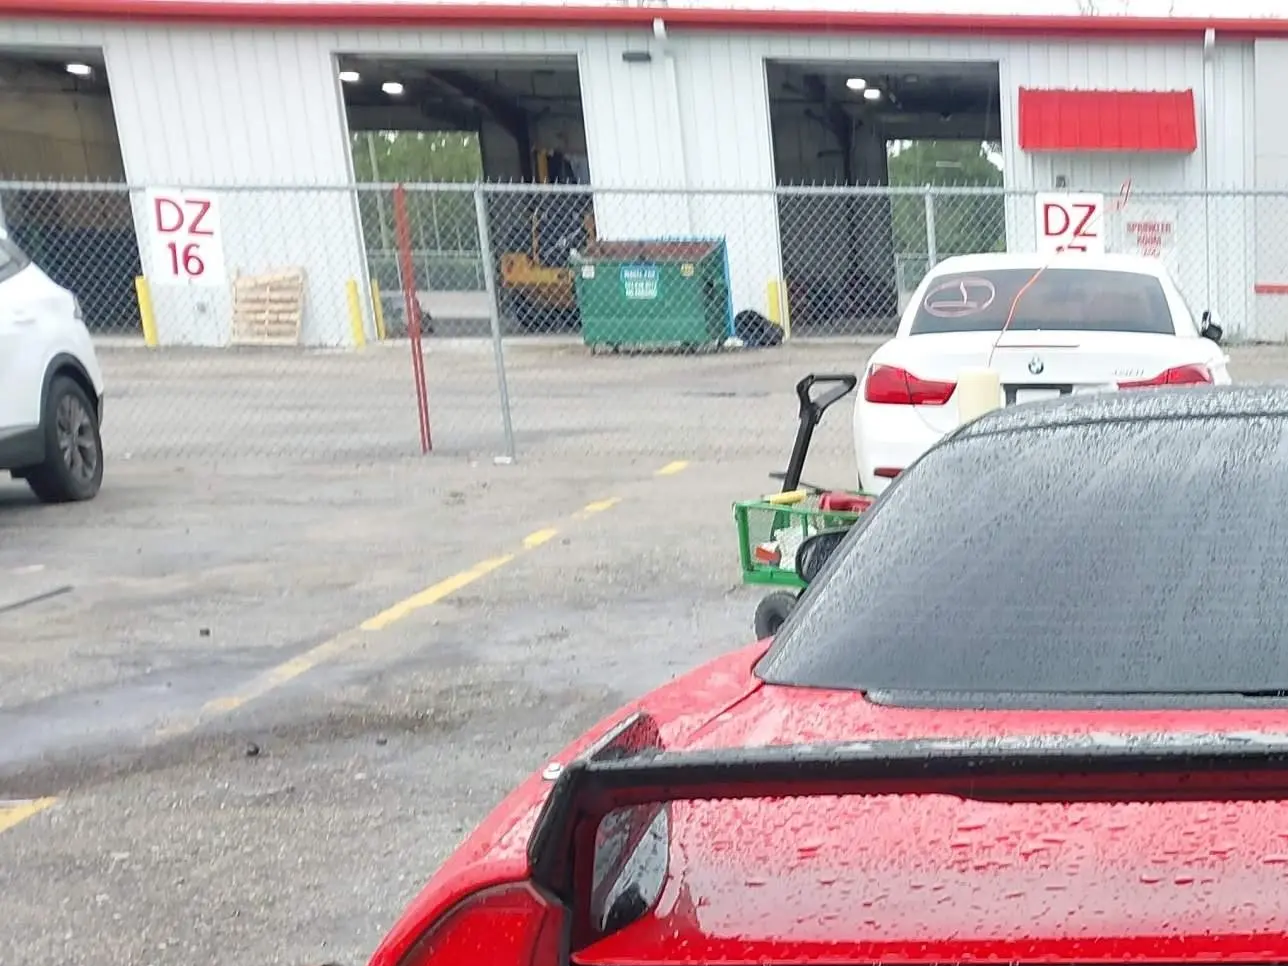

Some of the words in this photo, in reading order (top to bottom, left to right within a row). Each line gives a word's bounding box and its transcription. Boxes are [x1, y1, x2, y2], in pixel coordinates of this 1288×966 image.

[154, 197, 214, 236] DZ
[1043, 203, 1097, 237] DZ
[167, 241, 205, 276] 16
